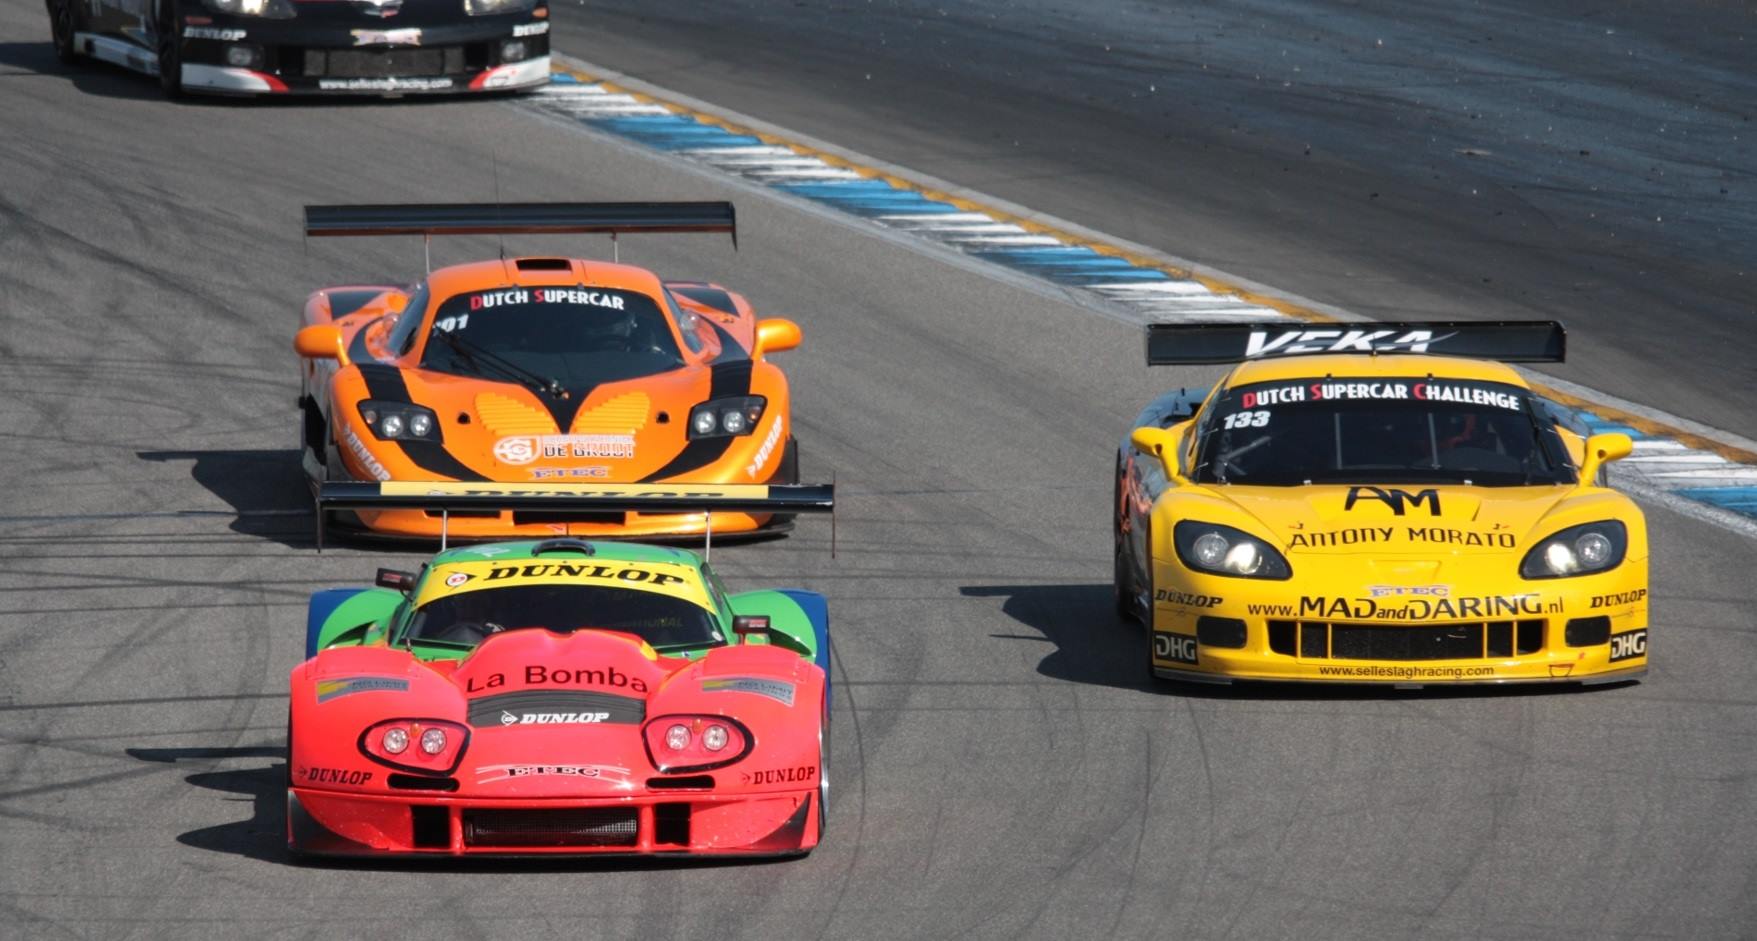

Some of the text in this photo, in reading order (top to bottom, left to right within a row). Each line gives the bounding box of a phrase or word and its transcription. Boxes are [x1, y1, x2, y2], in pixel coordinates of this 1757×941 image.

[183, 27, 247, 41] DUNLOP
[470, 289, 625, 310] DUTCH SUPERCAR
[1245, 331, 1433, 357] VEKA
[1243, 384, 1520, 411] DUTCH SUPERCAR CHALLENGE
[1224, 411, 1271, 430] 133
[1290, 527, 1516, 549] ANTONY MORATO
[483, 565, 684, 586] DUNLOP
[1155, 589, 1223, 608] DUNLOP
[1590, 588, 1647, 608] DUNLOP
[1156, 635, 1196, 660] DHG
[1611, 632, 1646, 659] DHG
[467, 666, 648, 693] La Bomba
[520, 712, 609, 724] DUNLOP
[308, 767, 373, 785] DUNLOP
[754, 766, 815, 785] DUNLOP
